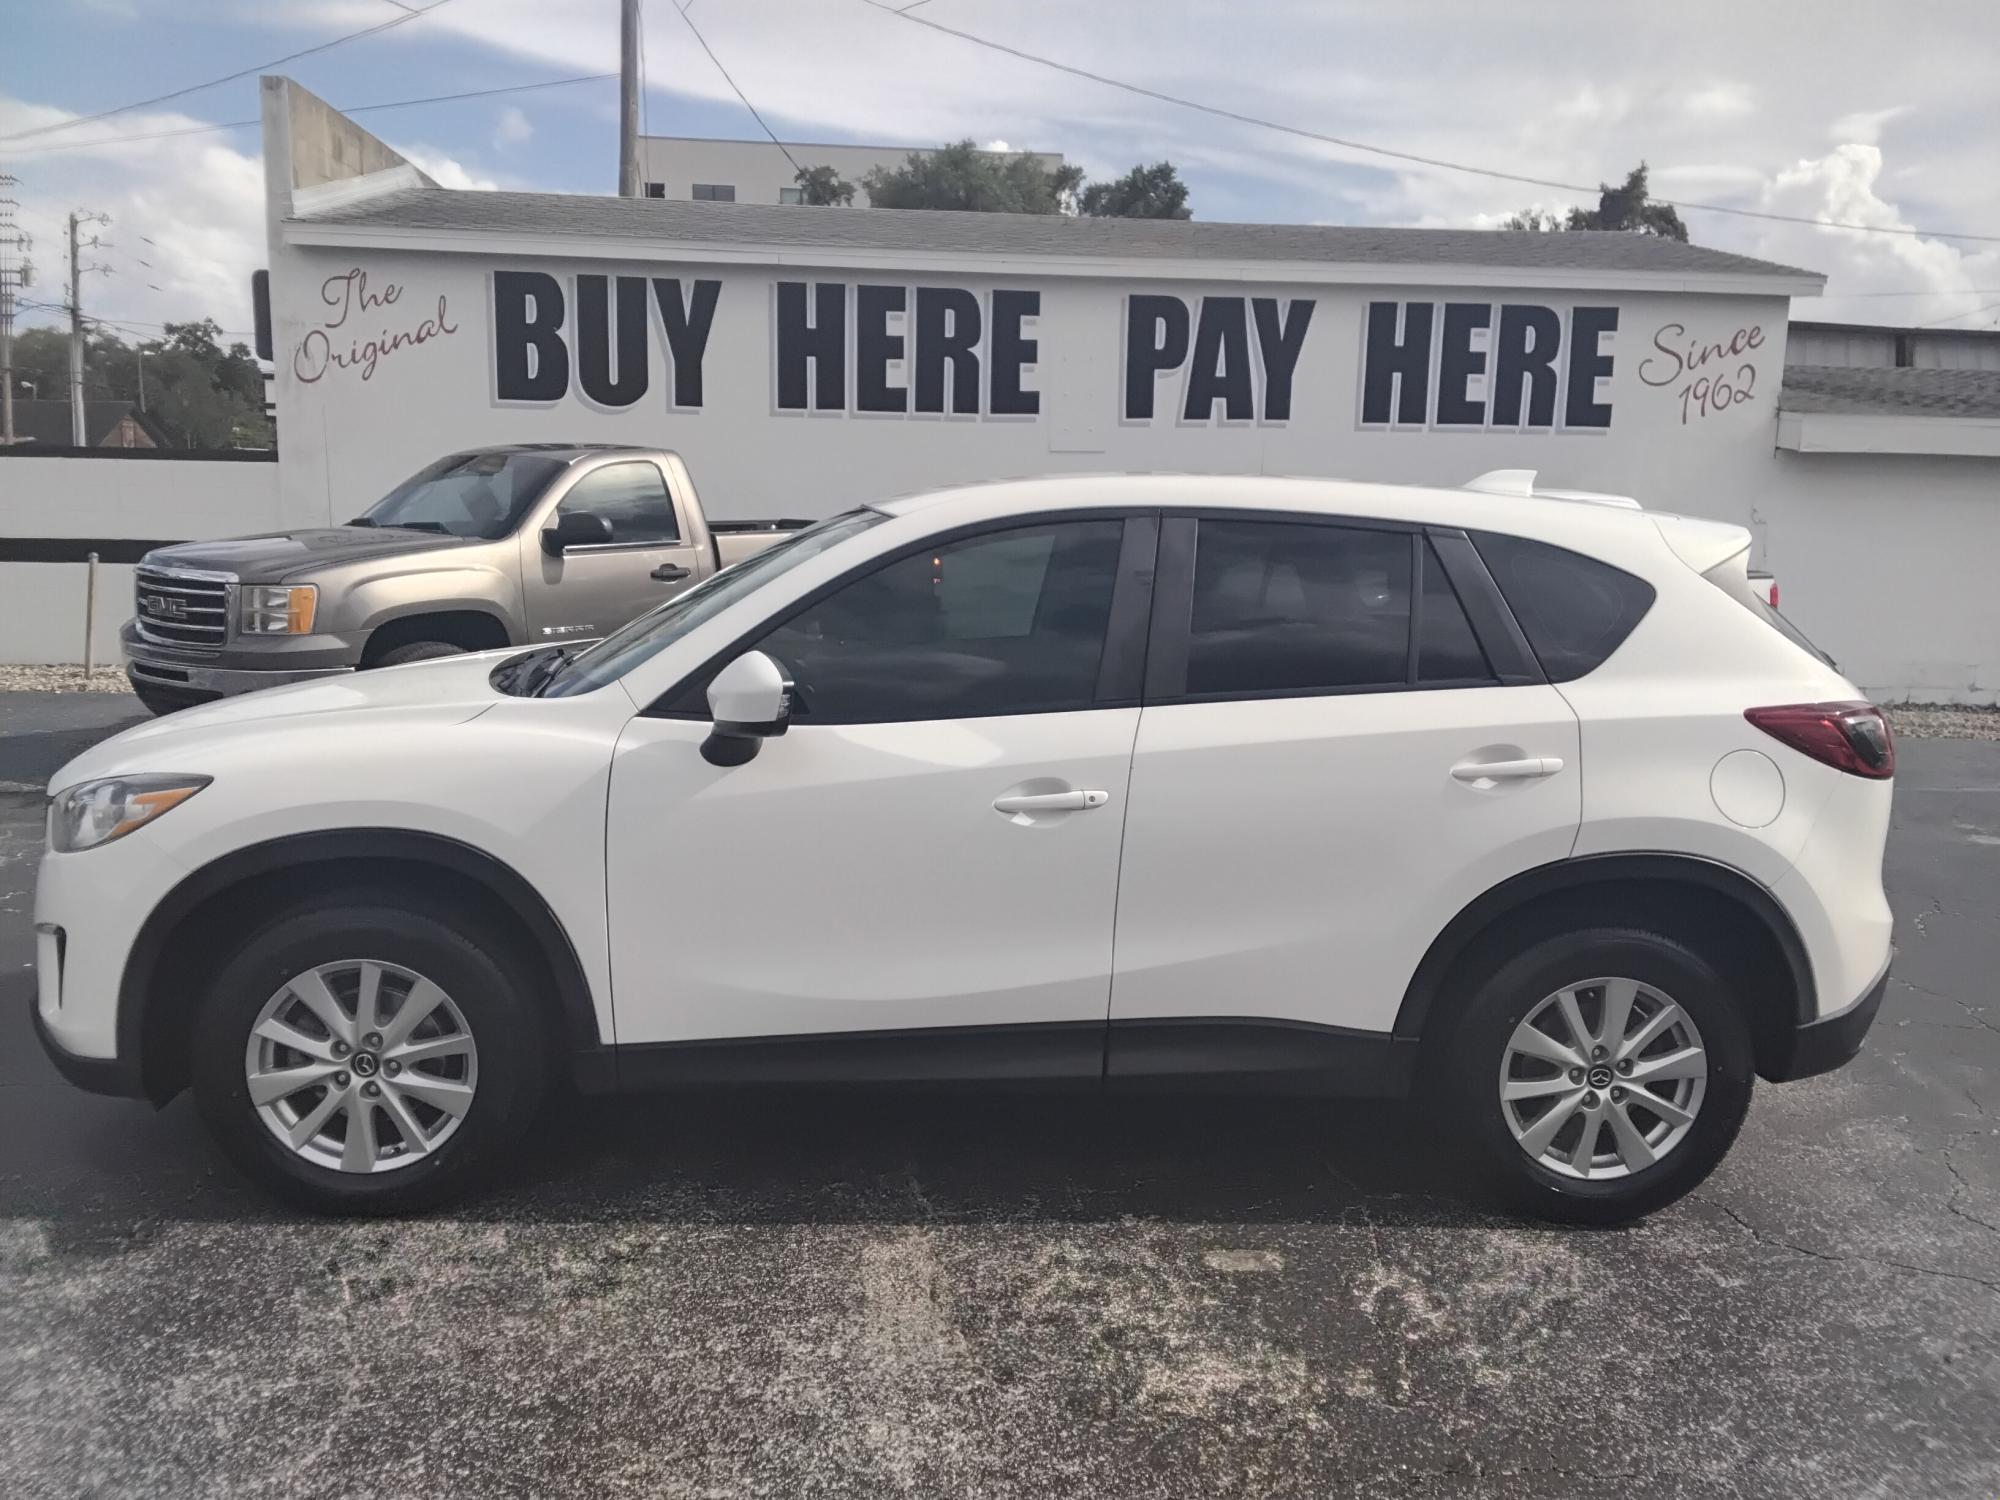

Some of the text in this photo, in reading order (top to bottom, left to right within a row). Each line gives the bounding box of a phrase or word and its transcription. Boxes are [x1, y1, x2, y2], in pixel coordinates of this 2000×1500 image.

[321, 267, 404, 328] The
[294, 295, 458, 383] Original
[492, 269, 1620, 429] BUY HERE PAY HERE
[1638, 323, 1765, 387] Since
[1678, 364, 1757, 425] 1962
[147, 595, 187, 619] GMC
